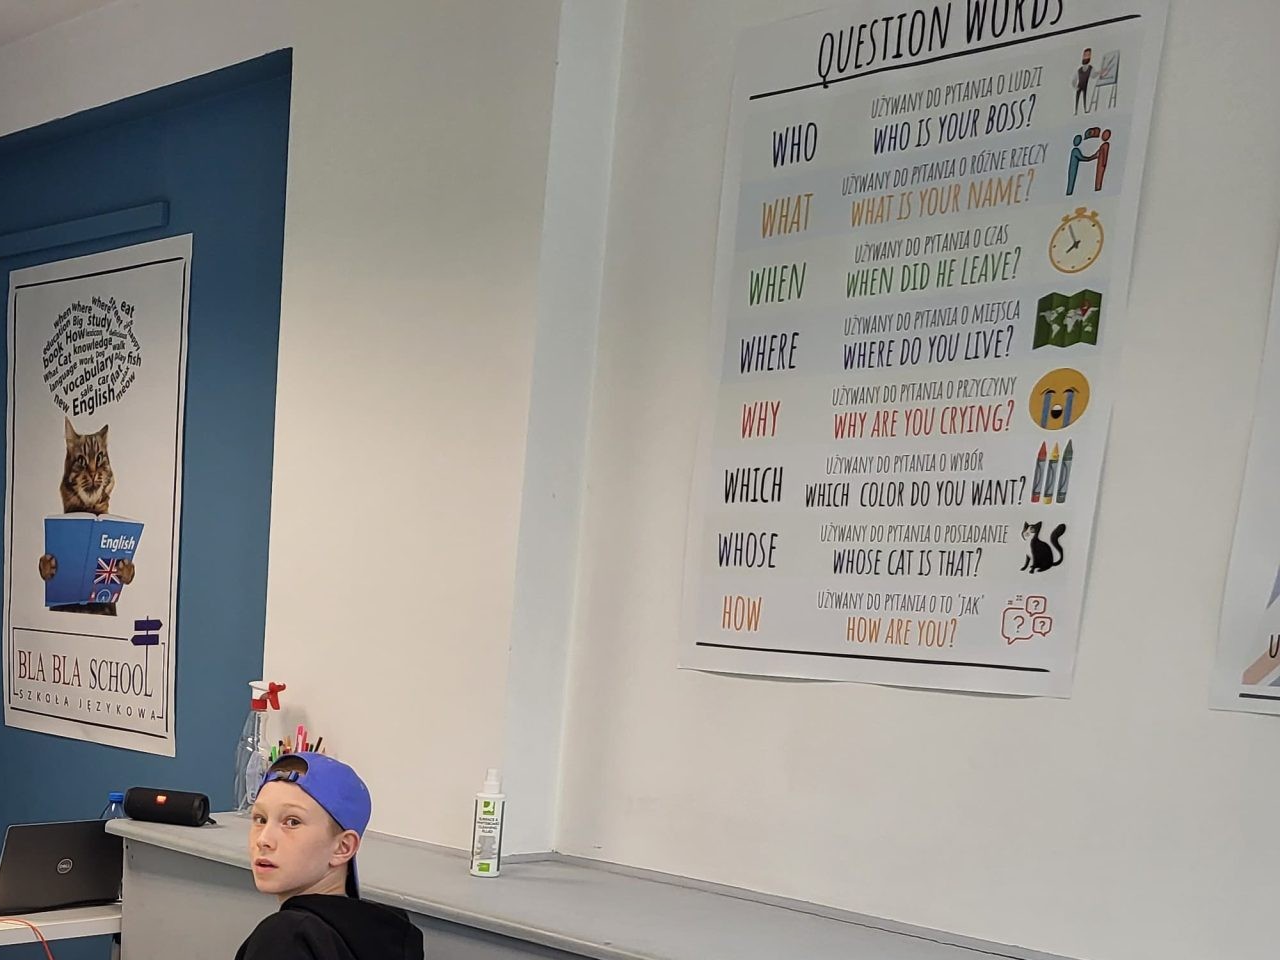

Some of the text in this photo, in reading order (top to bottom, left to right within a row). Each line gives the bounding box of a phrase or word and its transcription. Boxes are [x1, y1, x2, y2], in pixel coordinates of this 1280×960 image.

[818, 2, 951, 88] QUESTION
[871, 66, 1043, 118] UŻYWANY DO PYTANIA O LUDZI
[873, 94, 1036, 154] WHO IS YOUR BOSS?
[773, 122, 817, 167] WHO
[842, 143, 1049, 196] UŻYWANY DO PYTANIA O RÓŻNE RZECZY
[851, 168, 1035, 227] WHAT IS YOUR NAME?
[761, 193, 814, 239] WHAT
[854, 224, 1009, 264] UŻYWANY DO PYTANIA O CZAS
[749, 262, 806, 307] WHEN
[846, 246, 1021, 298] WHEN DID HE LEAVE?
[53, 306, 71, 329] when
[72, 300, 92, 314] where
[92, 296, 111, 314] where
[120, 301, 135, 318] eat
[844, 300, 1020, 336] UŻYWANY DO PYTANIA O MIEJSCA
[43, 319, 71, 355] education
[72, 315, 83, 329] Big
[87, 313, 112, 332] study
[42, 341, 64, 370] book
[58, 352, 72, 367] Cat
[73, 337, 113, 355] knowledge
[79, 354, 95, 366] work
[127, 351, 142, 367] fish
[740, 332, 799, 374] WHERE
[843, 325, 1014, 370] WHERE DO YOU LIVE?
[43, 367, 59, 383] What
[49, 361, 78, 393] language
[63, 353, 115, 396] vocabulary
[97, 374, 109, 386] car
[116, 371, 136, 402] meow
[54, 394, 69, 413] new
[72, 384, 115, 416] English
[80, 384, 93, 399] sale
[832, 376, 1018, 406] UŻYWANY DO PYTANIA O PRZYCZYNY
[741, 400, 781, 439] WHY
[834, 400, 1015, 440] WHY ARE YOU CRYING?
[826, 449, 984, 475] UŻYWANY DO PYTANIA O WYBÓR
[725, 466, 783, 504] WHICH
[805, 475, 1027, 508] WHICH COLOR DO YOU WANT?
[100, 534, 136, 552] English
[820, 522, 1009, 544] UŻYWANY DO PYTANIA O POSIADANIE
[718, 532, 778, 568] WHOSE
[833, 548, 983, 577] WHOSE CAT IS THAT?
[722, 595, 762, 632] HOW
[817, 589, 864, 610] UŻYWANY
[866, 593, 881, 611] DO
[884, 594, 926, 613] PYTANIA
[929, 594, 936, 613] O
[938, 594, 952, 614] TO
[846, 616, 958, 648] HOW ARE YOU?
[18, 650, 153, 697] BLA BLA SCHOOL
[20, 689, 156, 721] SZKOŁA JĘZYKOWA
